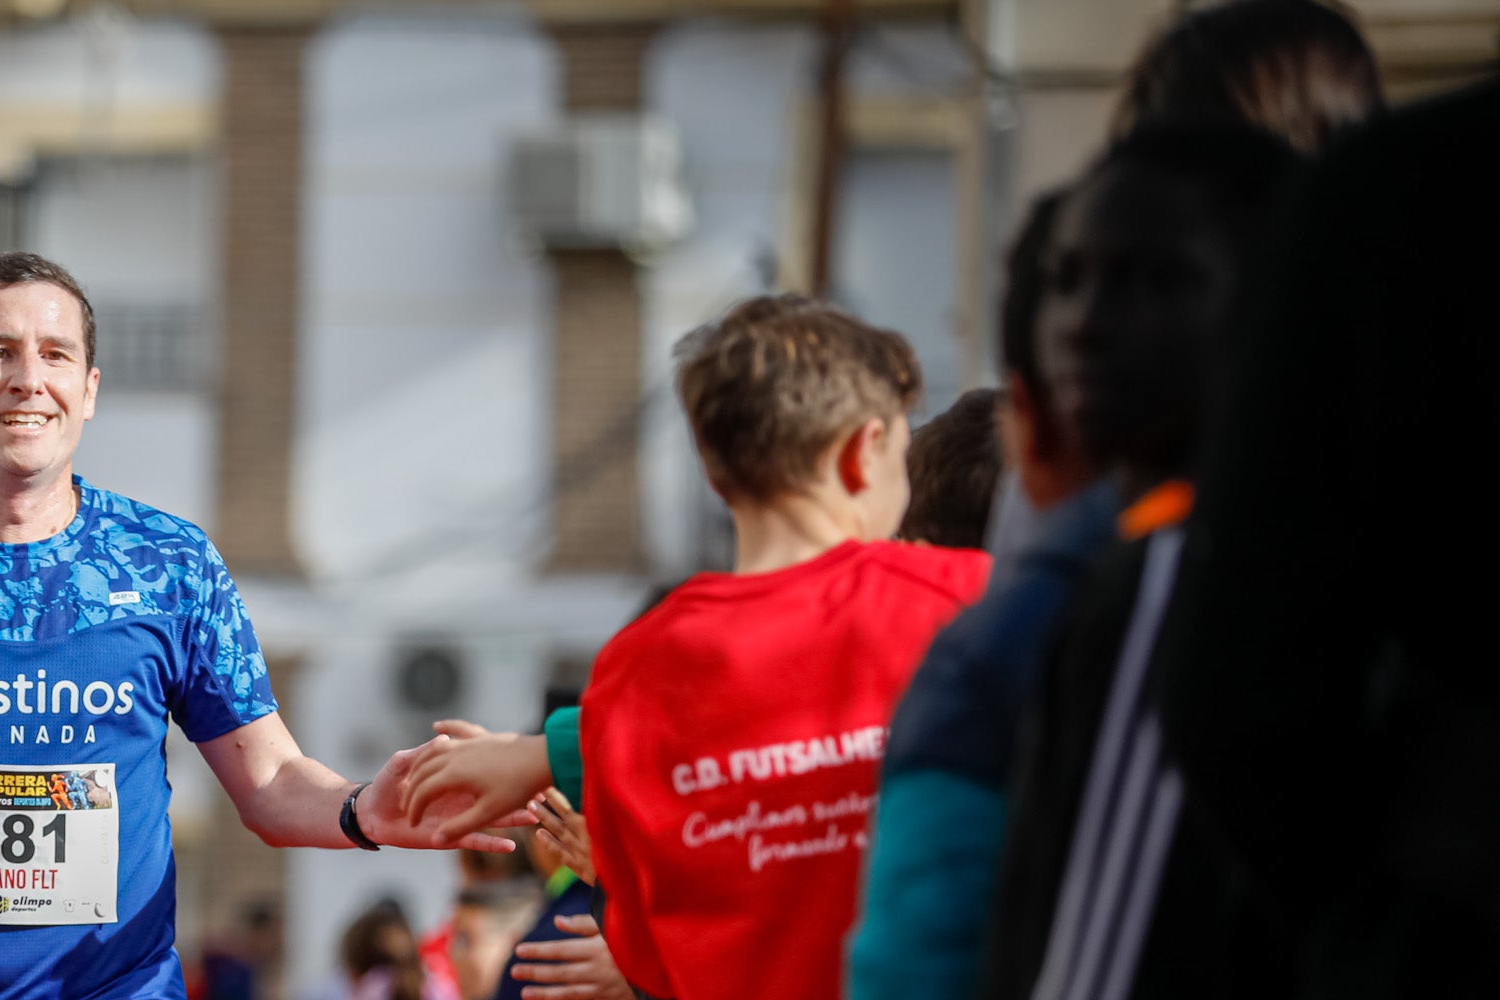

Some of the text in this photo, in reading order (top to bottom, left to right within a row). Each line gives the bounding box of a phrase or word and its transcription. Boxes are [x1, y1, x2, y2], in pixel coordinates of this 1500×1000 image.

[671, 757, 729, 796] C.D.
[32, 869, 58, 889] FLT
[12, 895, 52, 908] olimpo
